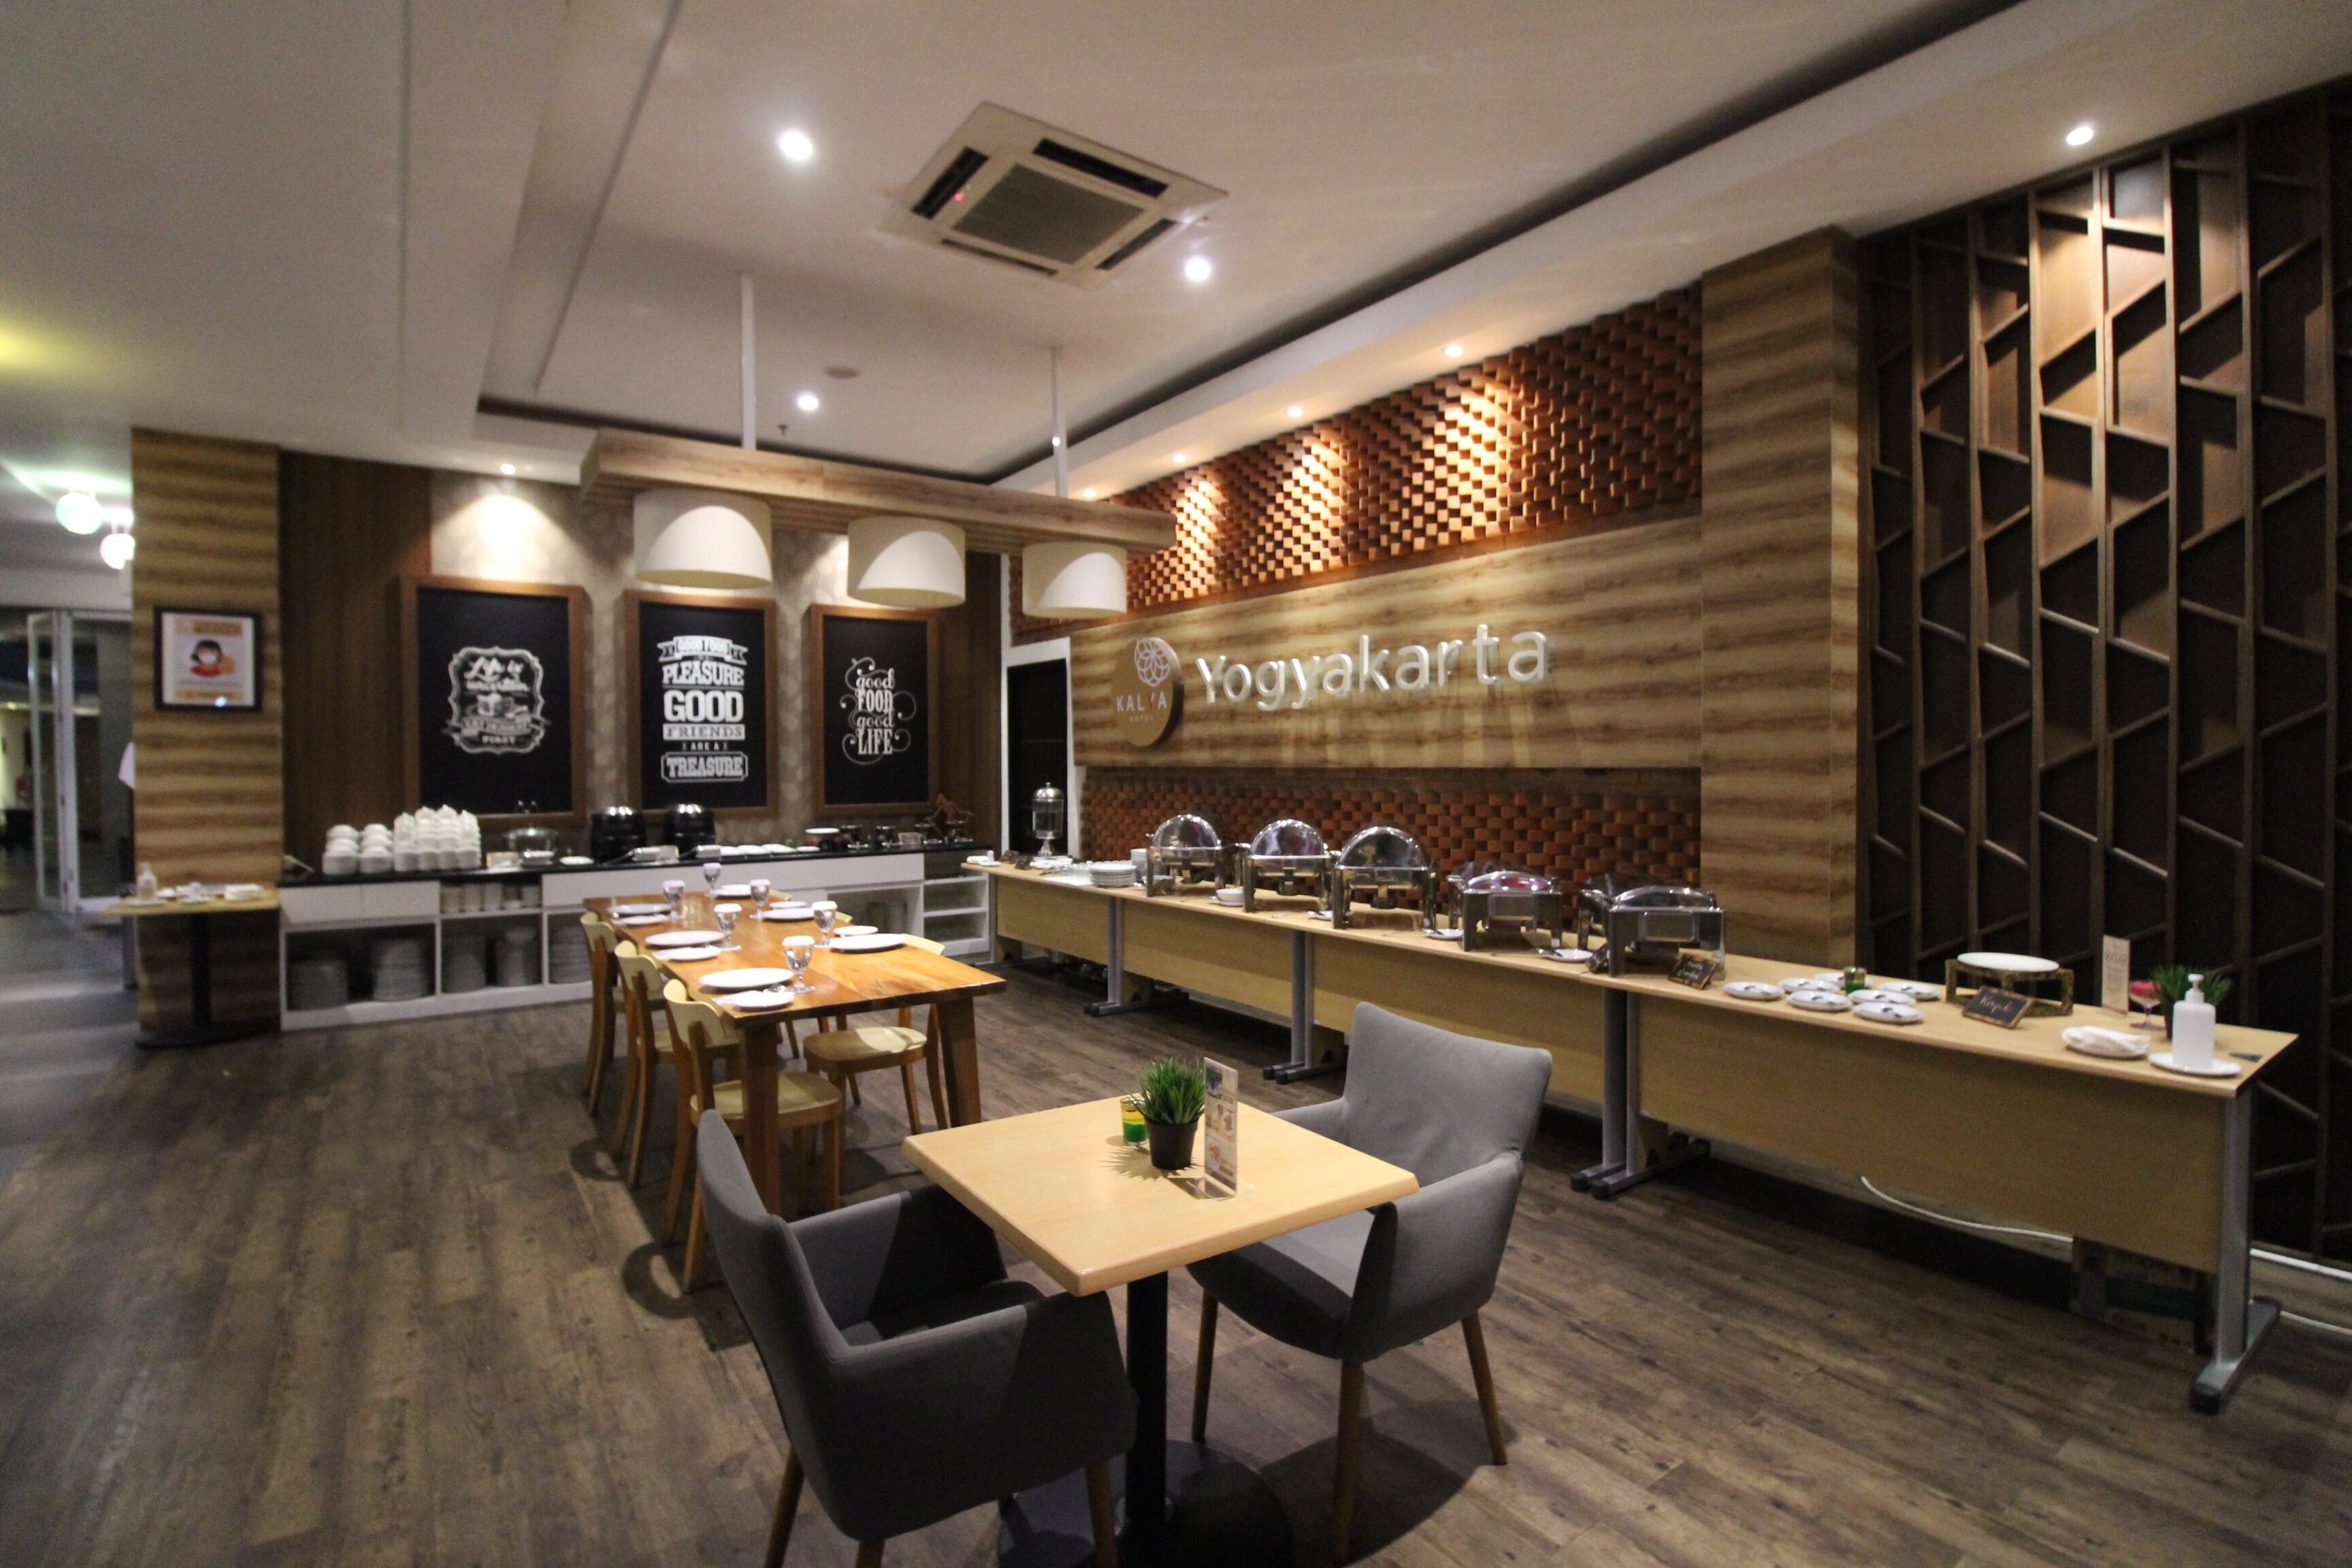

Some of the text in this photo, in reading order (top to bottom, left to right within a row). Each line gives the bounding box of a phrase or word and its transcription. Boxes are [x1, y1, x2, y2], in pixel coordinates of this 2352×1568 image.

[662, 660, 745, 686] PLEASURE
[1195, 624, 1548, 710] Yogyakarta
[855, 668, 895, 696] good
[664, 690, 745, 722] GOOD
[857, 689, 894, 712] FOOD
[667, 725, 742, 737] FRIENDS
[856, 708, 894, 734] good
[858, 728, 894, 755] LIFE
[666, 756, 744, 778] TREASURE
